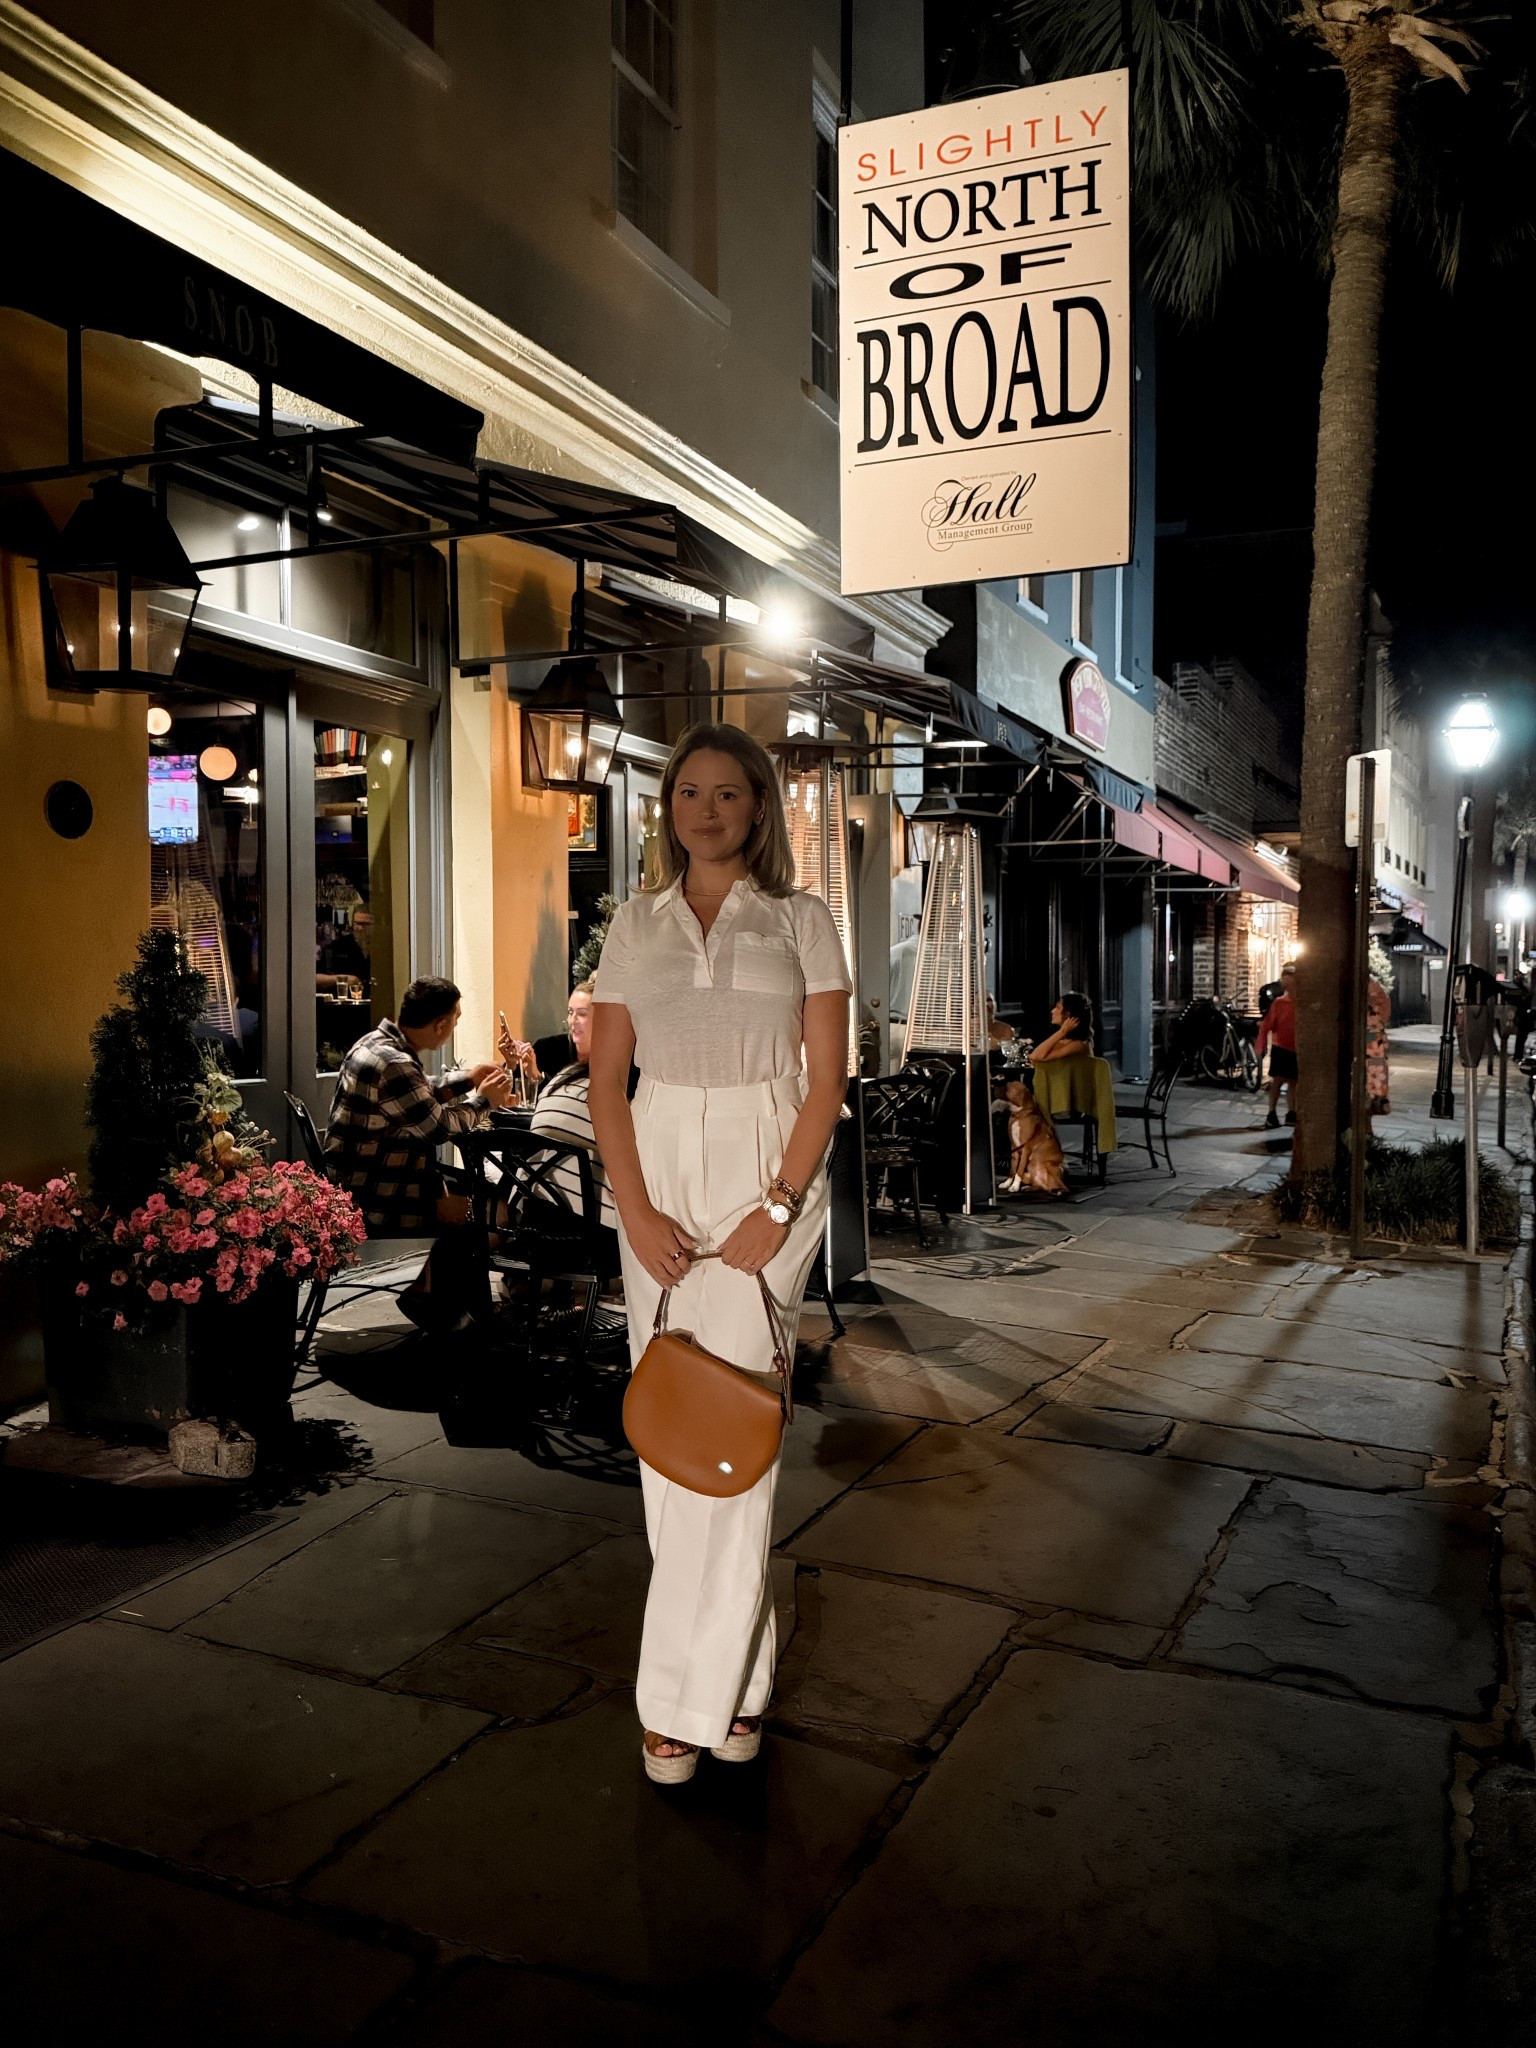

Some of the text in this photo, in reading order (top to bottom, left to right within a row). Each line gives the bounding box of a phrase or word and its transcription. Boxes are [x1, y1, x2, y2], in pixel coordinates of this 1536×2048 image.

[857, 107, 1107, 182] SLIGHTLY
[862, 160, 1102, 255] NORTH
[890, 243, 1072, 299] OF
[857, 296, 1110, 453] BROAD
[921, 472, 1037, 540] Hall
[938, 522, 1032, 540] Management Group
